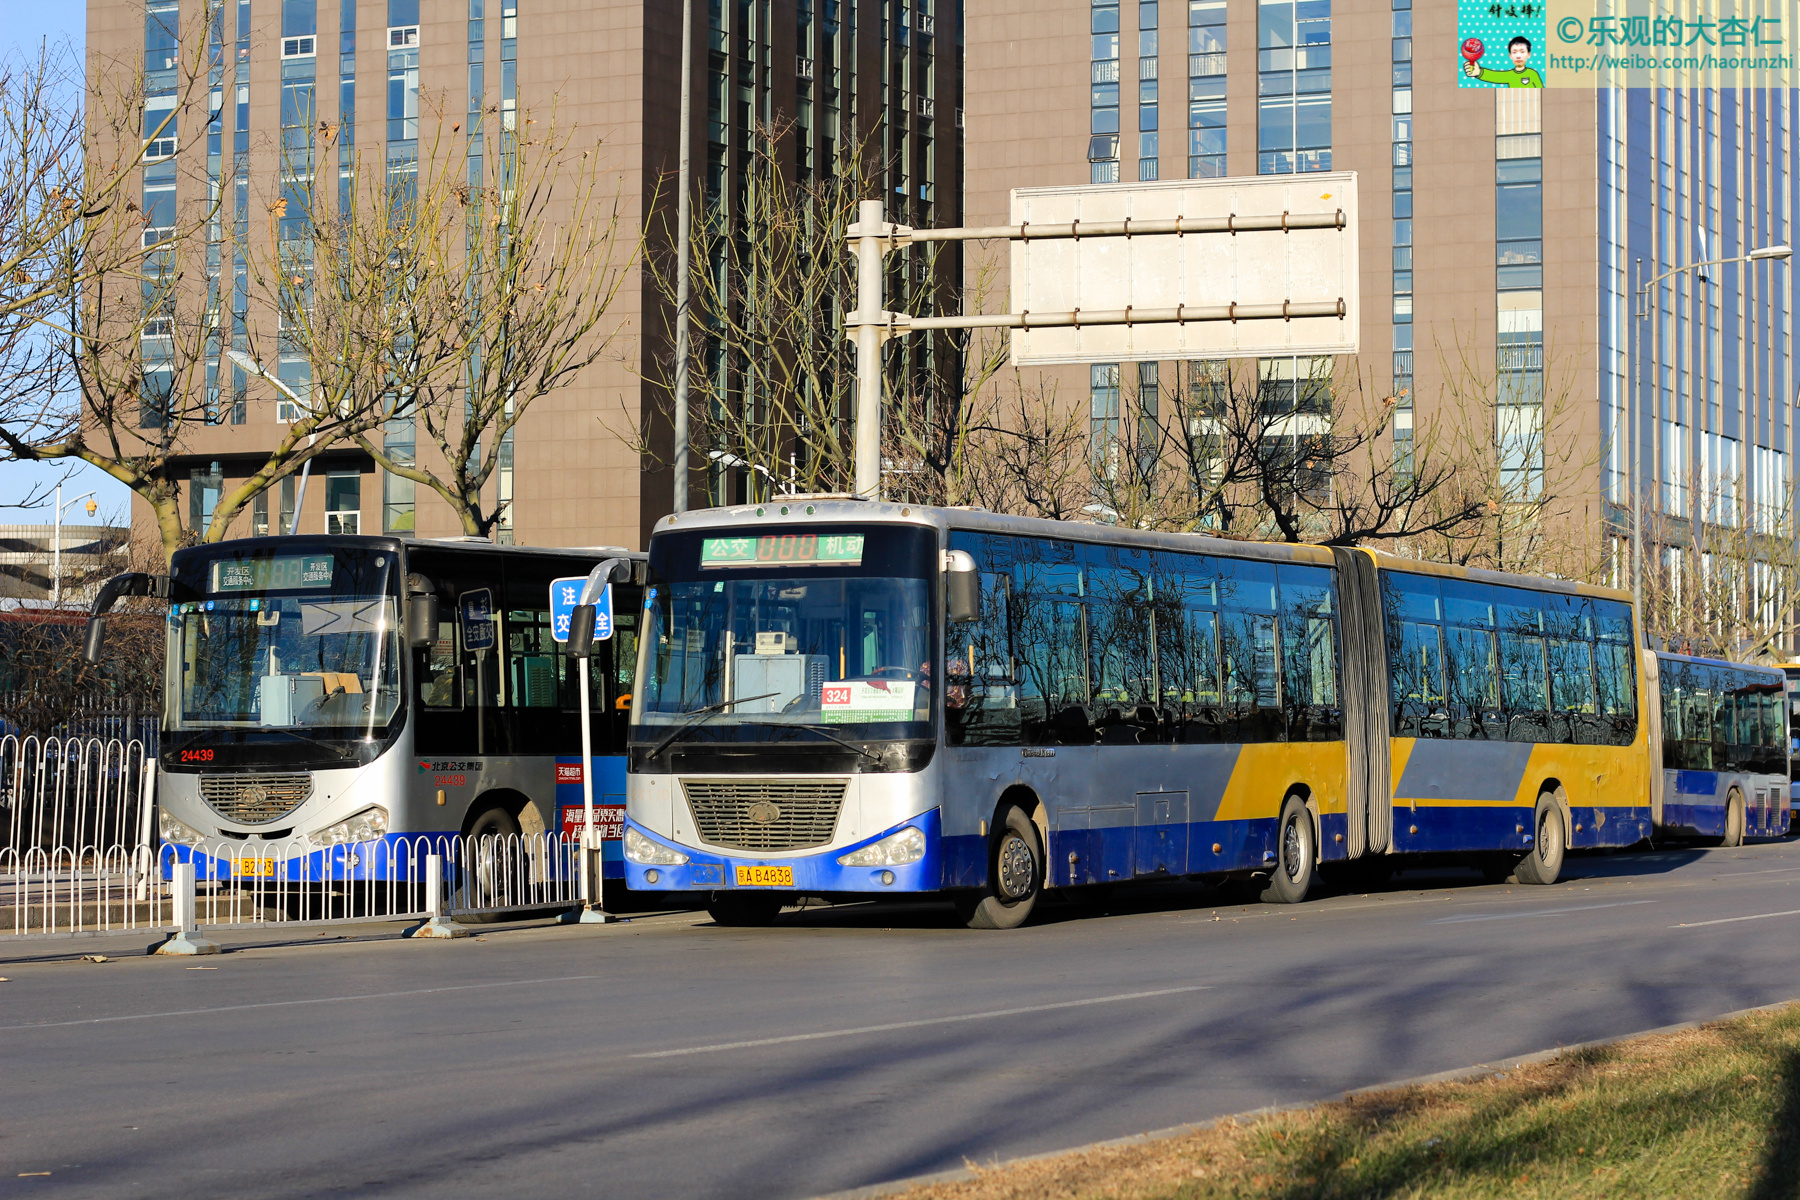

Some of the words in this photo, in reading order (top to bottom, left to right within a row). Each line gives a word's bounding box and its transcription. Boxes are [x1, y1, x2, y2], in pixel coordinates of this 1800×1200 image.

[710, 539, 749, 557] 公交
[826, 536, 864, 555] 机动
[227, 566, 249, 576] 开发区
[310, 562, 328, 571] 开发区
[557, 612, 609, 633] 交全
[826, 689, 848, 703] 324
[181, 749, 214, 762] 24439
[432, 761, 484, 772] 北京公交集团
[434, 774, 466, 787] 24439
[565, 808, 625, 823] 海量品更实惠
